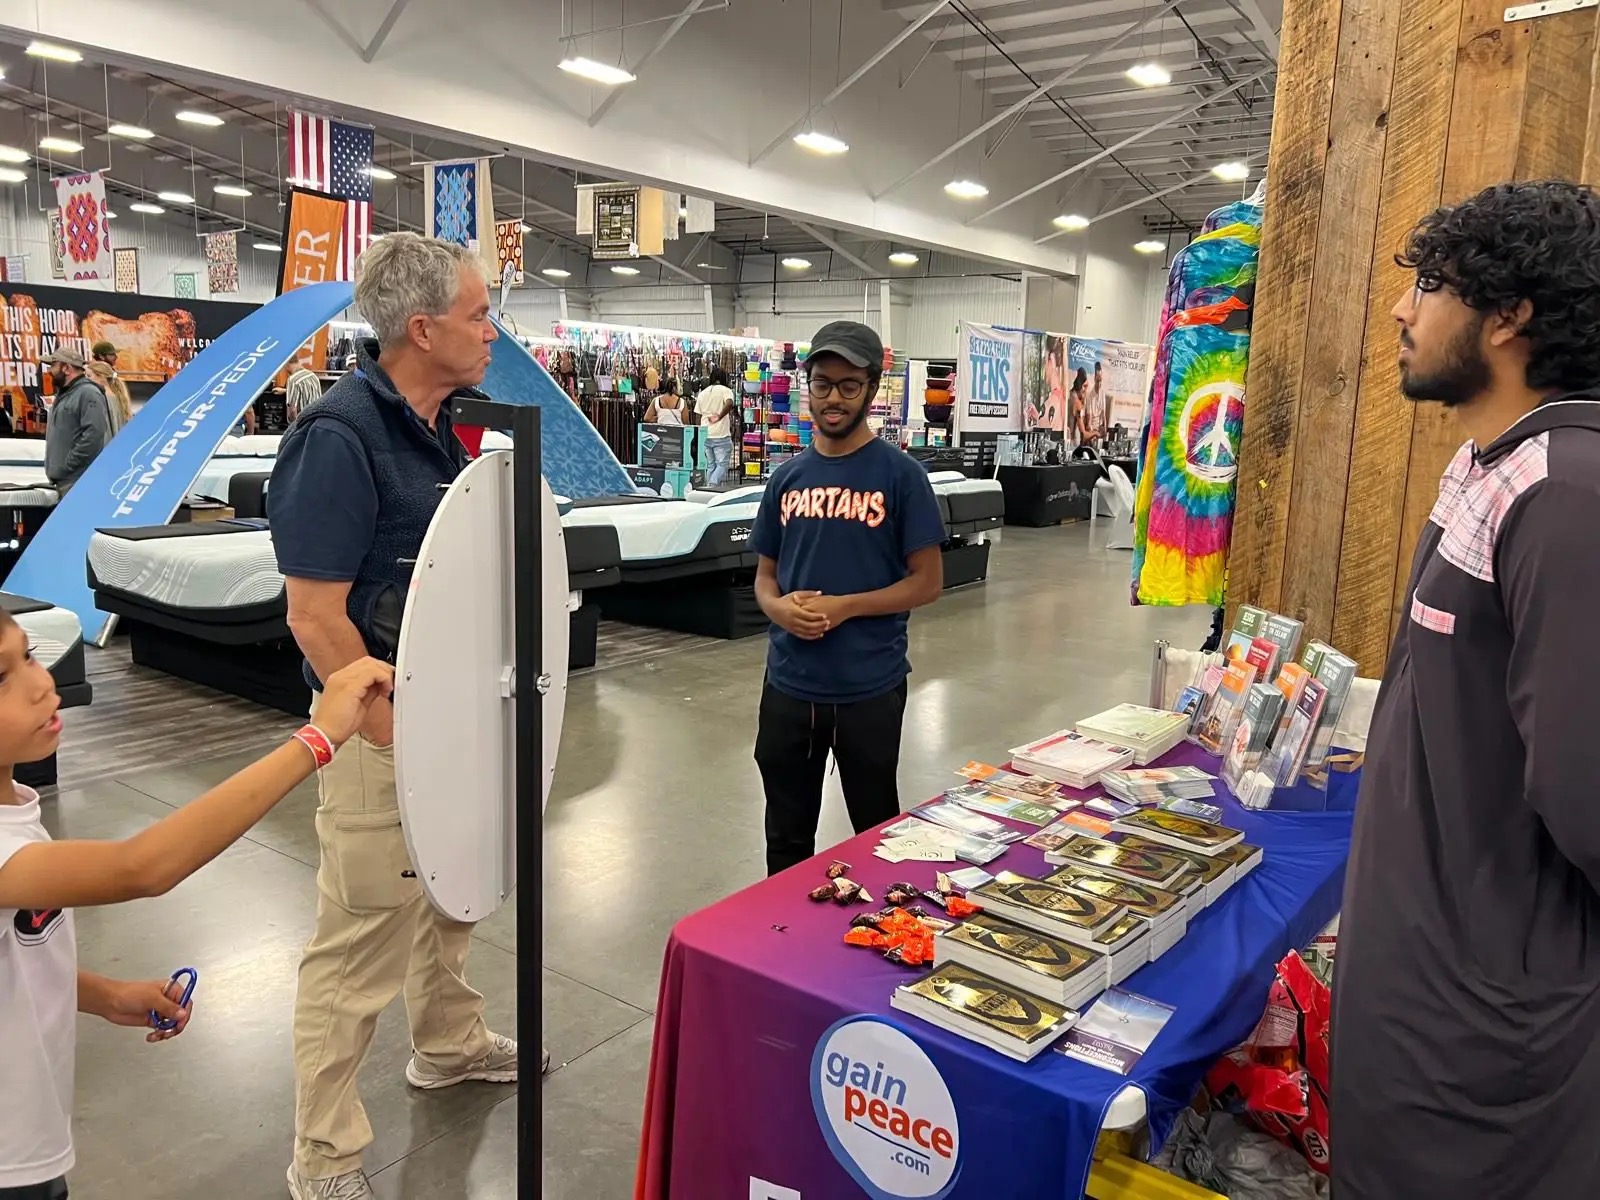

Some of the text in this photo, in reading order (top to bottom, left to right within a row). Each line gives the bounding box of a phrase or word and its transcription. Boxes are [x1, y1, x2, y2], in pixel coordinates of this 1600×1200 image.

[3, 305, 33, 332] THIS
[25, 334, 57, 359] PLAY
[969, 335, 1011, 358] BETTER THAN
[969, 353, 1010, 402] TENS
[112, 337, 279, 519] TEMPUR-PEDIC
[634, 476, 654, 484] ADAPT
[781, 487, 887, 528] SPARTANS
[1064, 1041, 1125, 1067] MISCONCEPTIONS
[826, 1052, 907, 1106] gain
[844, 1084, 954, 1159] peace
[890, 1151, 930, 1176] .com
